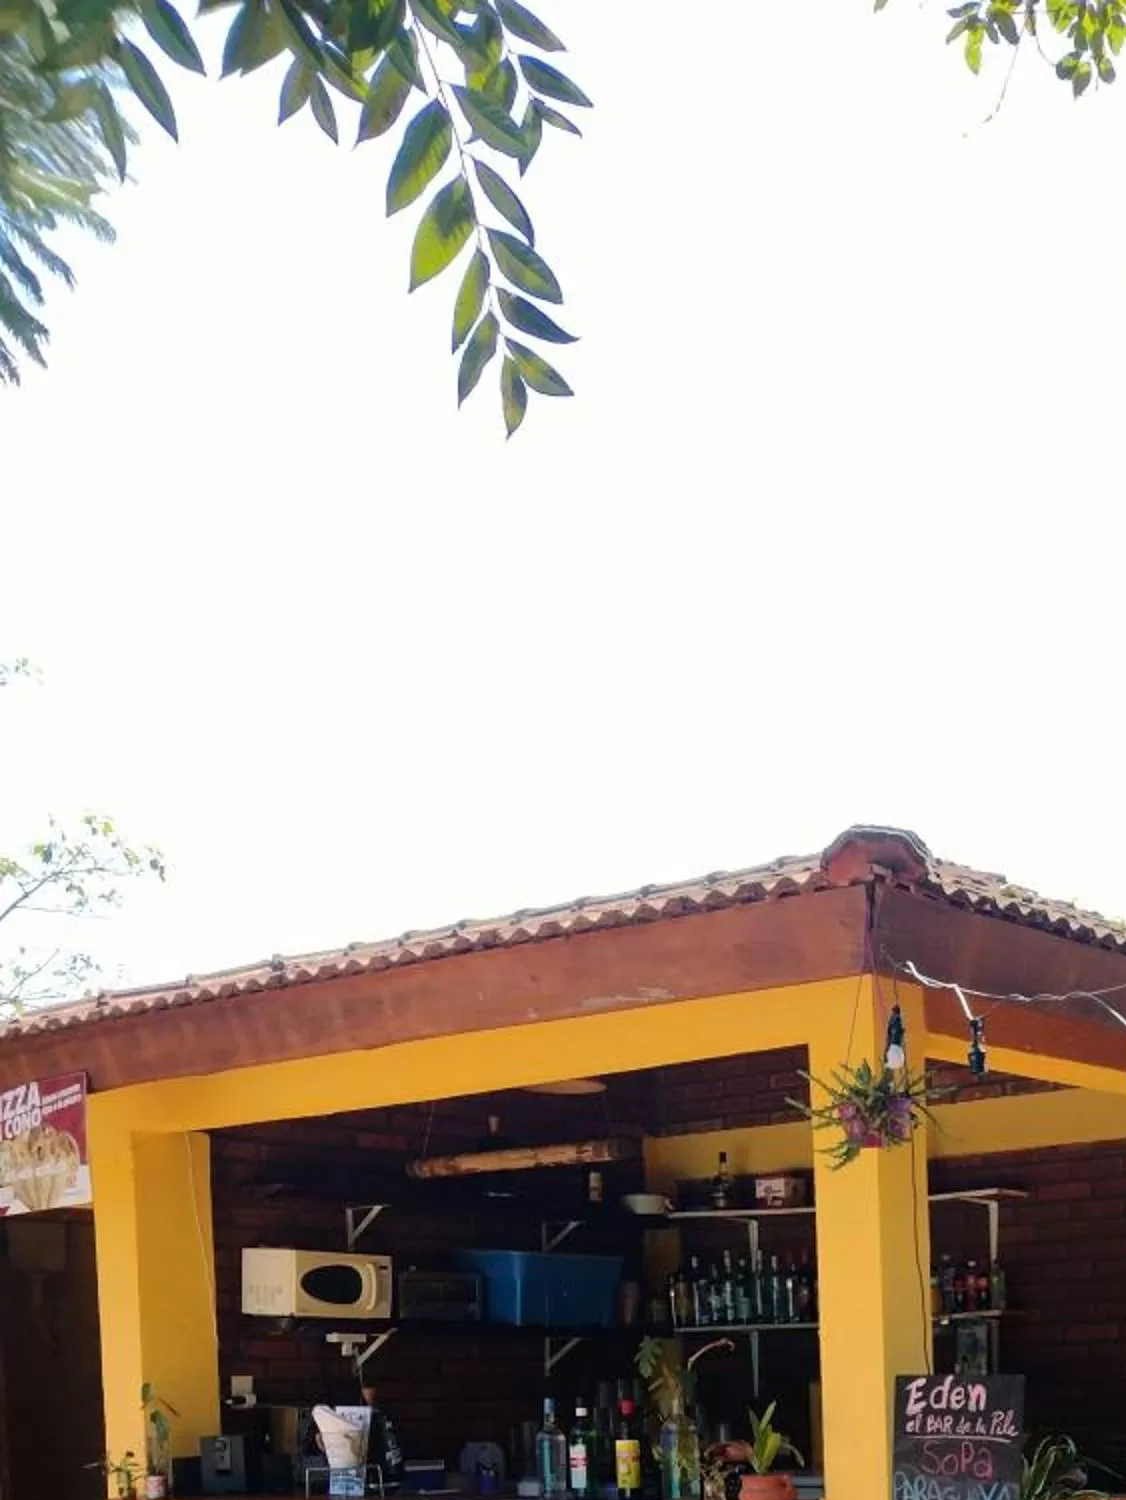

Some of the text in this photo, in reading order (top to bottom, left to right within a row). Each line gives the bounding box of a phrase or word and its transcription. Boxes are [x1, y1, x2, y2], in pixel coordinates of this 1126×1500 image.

[5, 1107, 41, 1139] CONO
[905, 1375, 987, 1415] Eden
[905, 1413, 923, 1434] el
[926, 1414, 953, 1434] BAR
[956, 1415, 971, 1435] de
